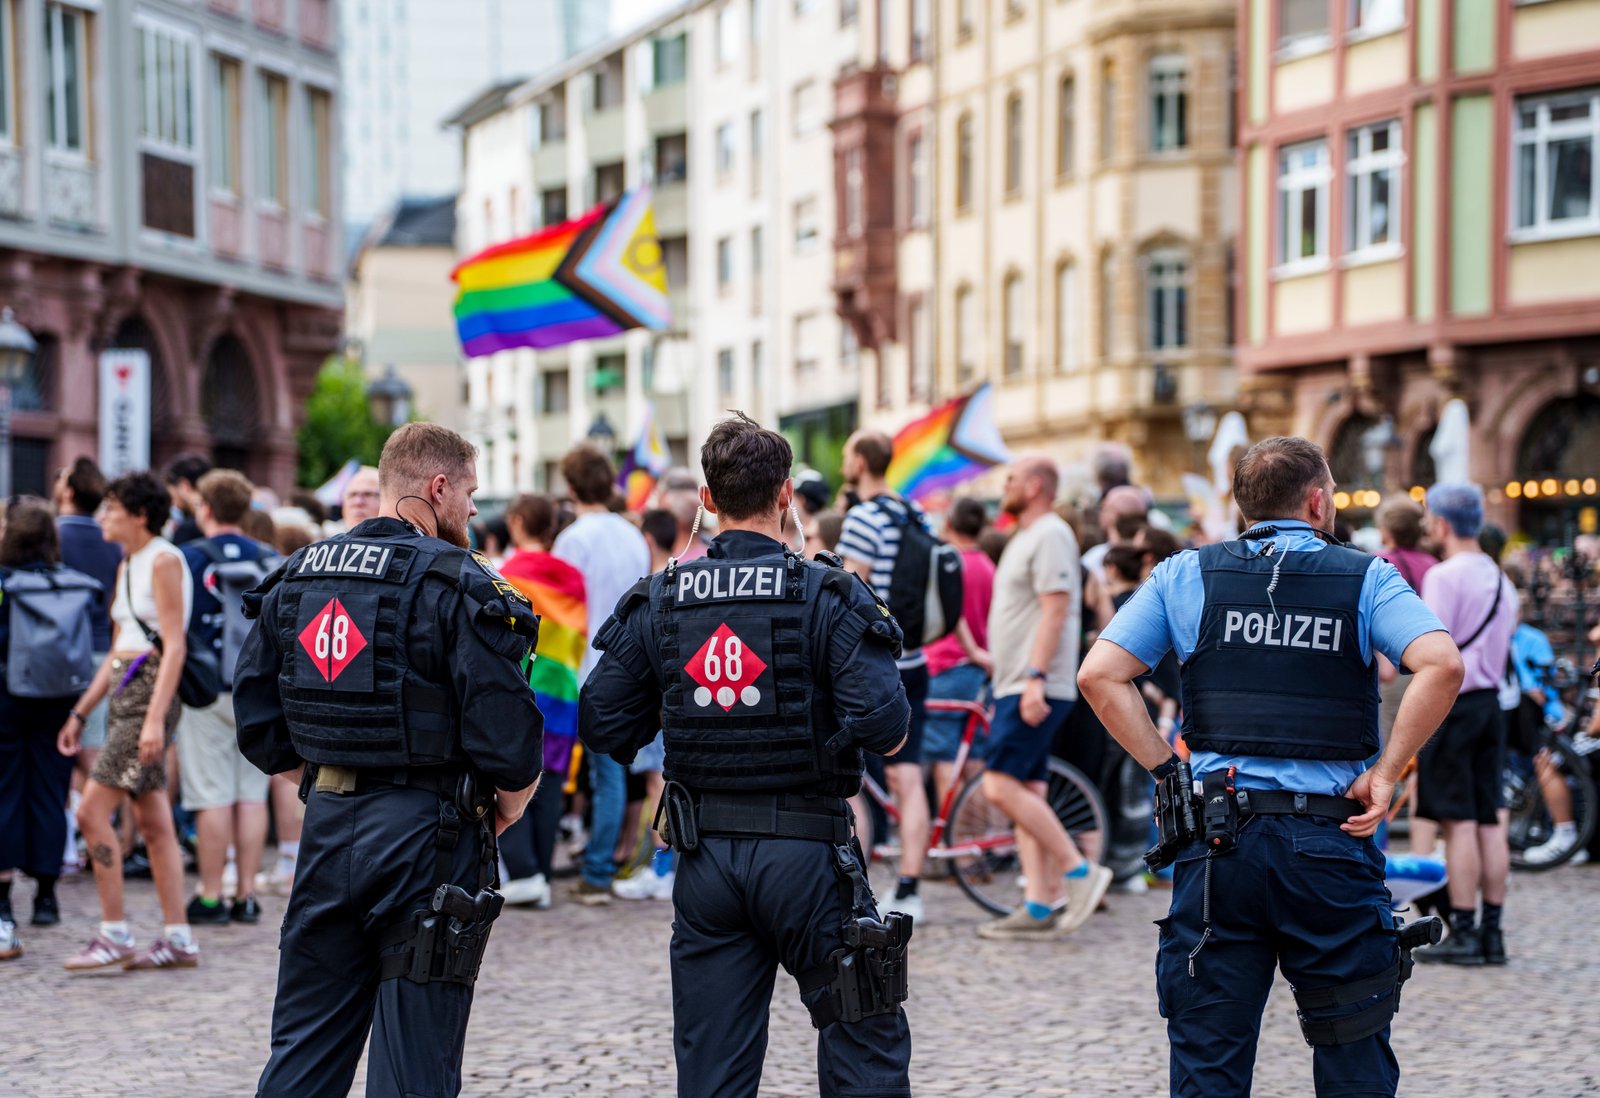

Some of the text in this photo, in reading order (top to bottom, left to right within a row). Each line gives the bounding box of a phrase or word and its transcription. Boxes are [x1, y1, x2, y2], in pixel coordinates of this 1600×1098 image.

[298, 543, 390, 575] POLIZEI
[678, 567, 783, 602] POLIZEI
[314, 614, 349, 660] 68
[1223, 610, 1342, 652] POLIZEI
[704, 635, 743, 683] 68
